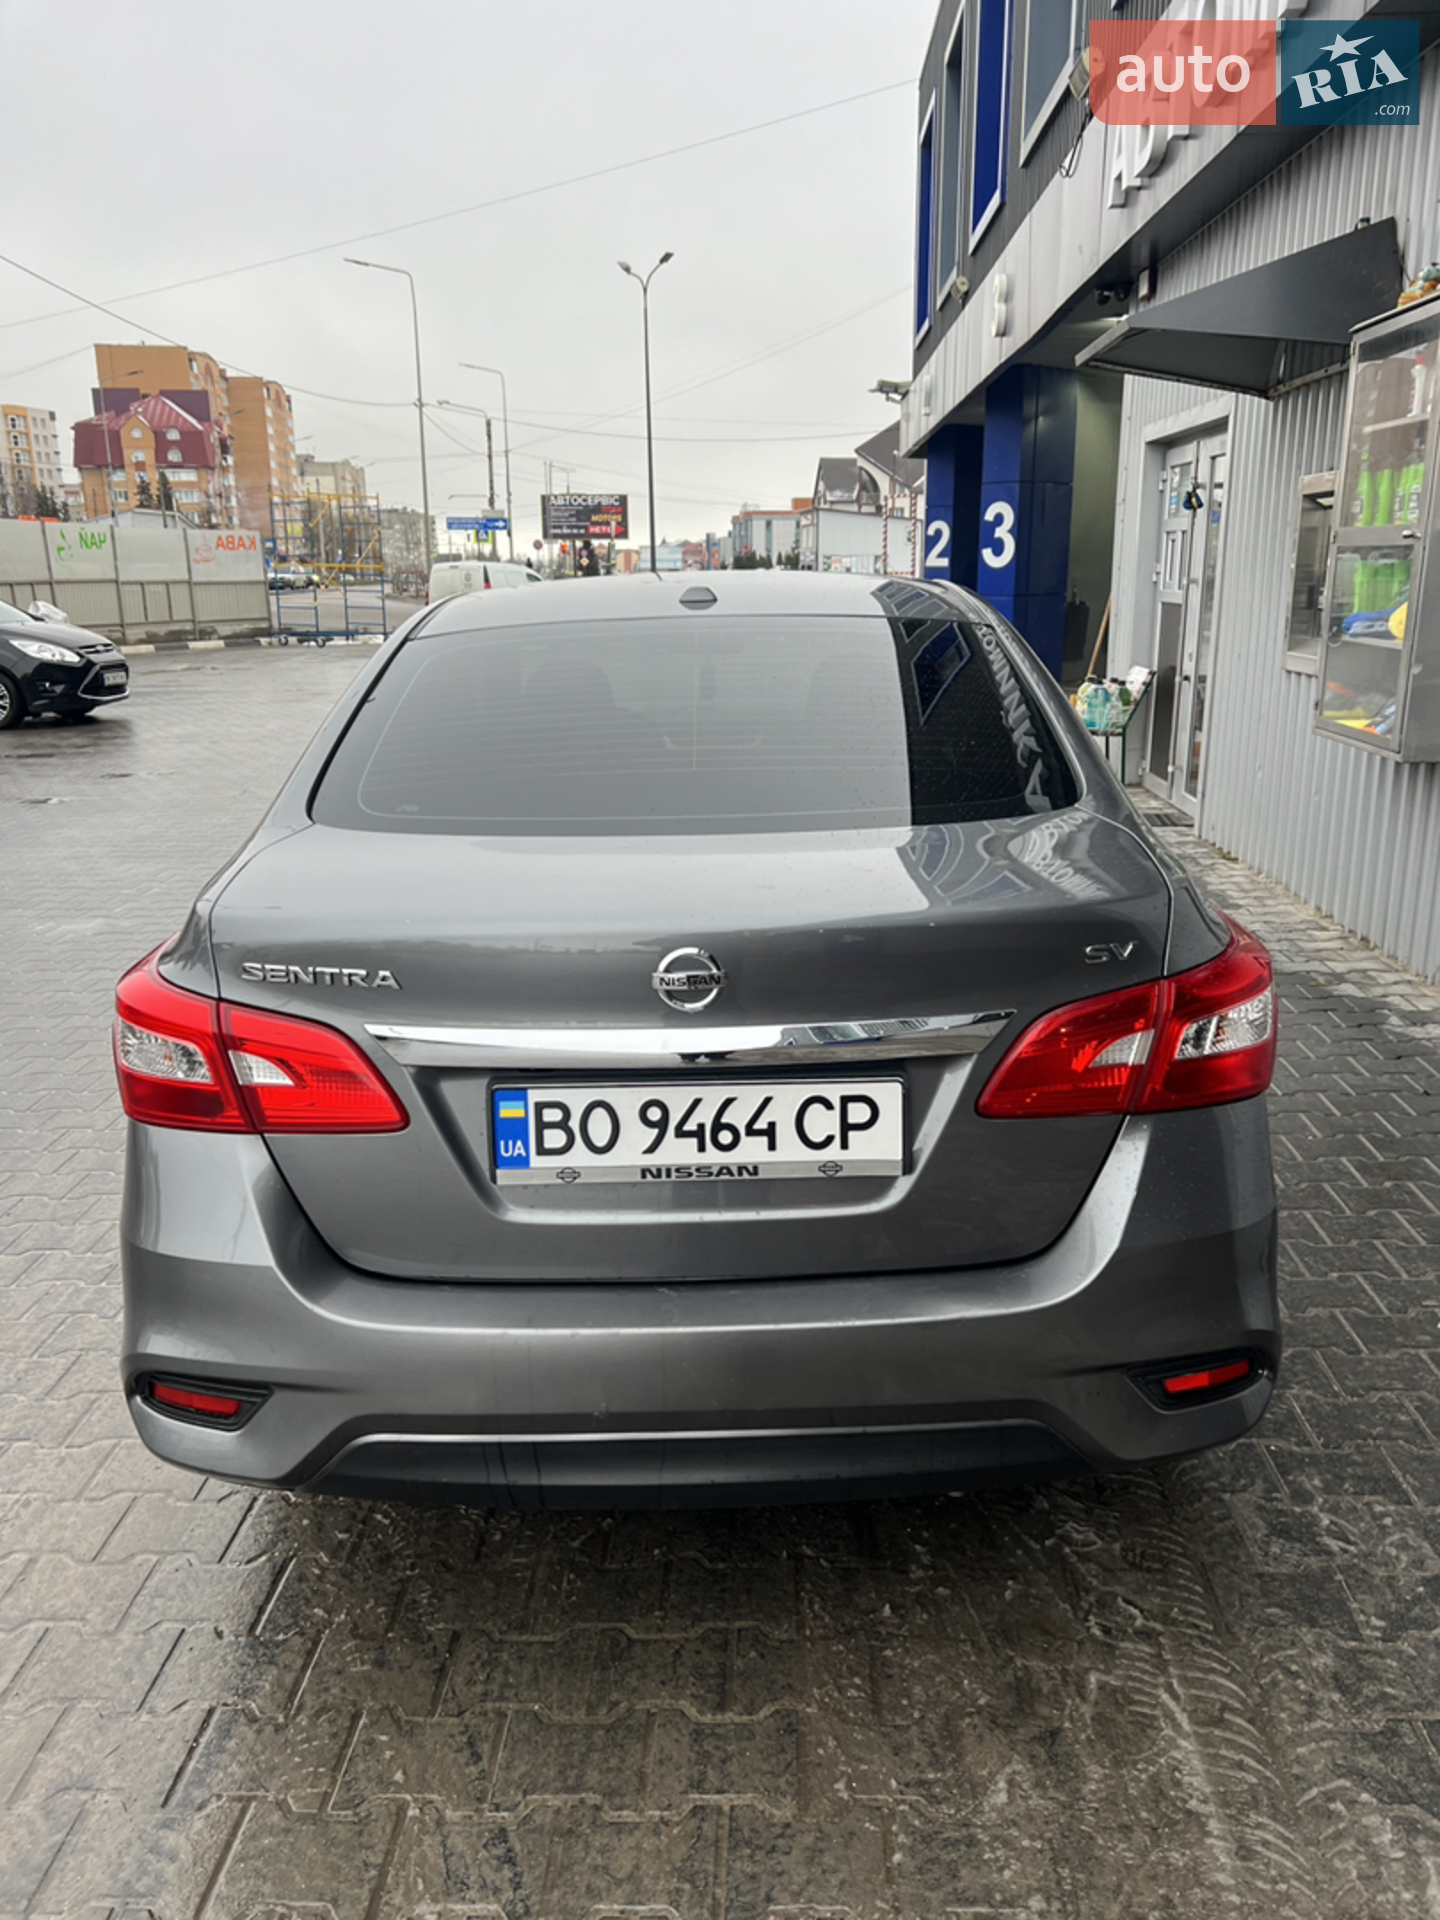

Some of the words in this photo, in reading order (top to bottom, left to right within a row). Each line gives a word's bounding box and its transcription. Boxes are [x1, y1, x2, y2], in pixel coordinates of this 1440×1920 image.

[549, 495, 621, 506] АВТОСЕРВІС
[924, 519, 951, 568] 2
[981, 500, 1017, 569] 3
[1083, 940, 1139, 965] SV
[240, 961, 404, 991] SENTRA
[658, 974, 722, 988] NISSAN
[533, 1098, 621, 1157] BO
[637, 1095, 778, 1155] 9464
[794, 1093, 881, 1151] CP
[499, 1139, 527, 1158] UA
[640, 1165, 760, 1180] NISSAN
